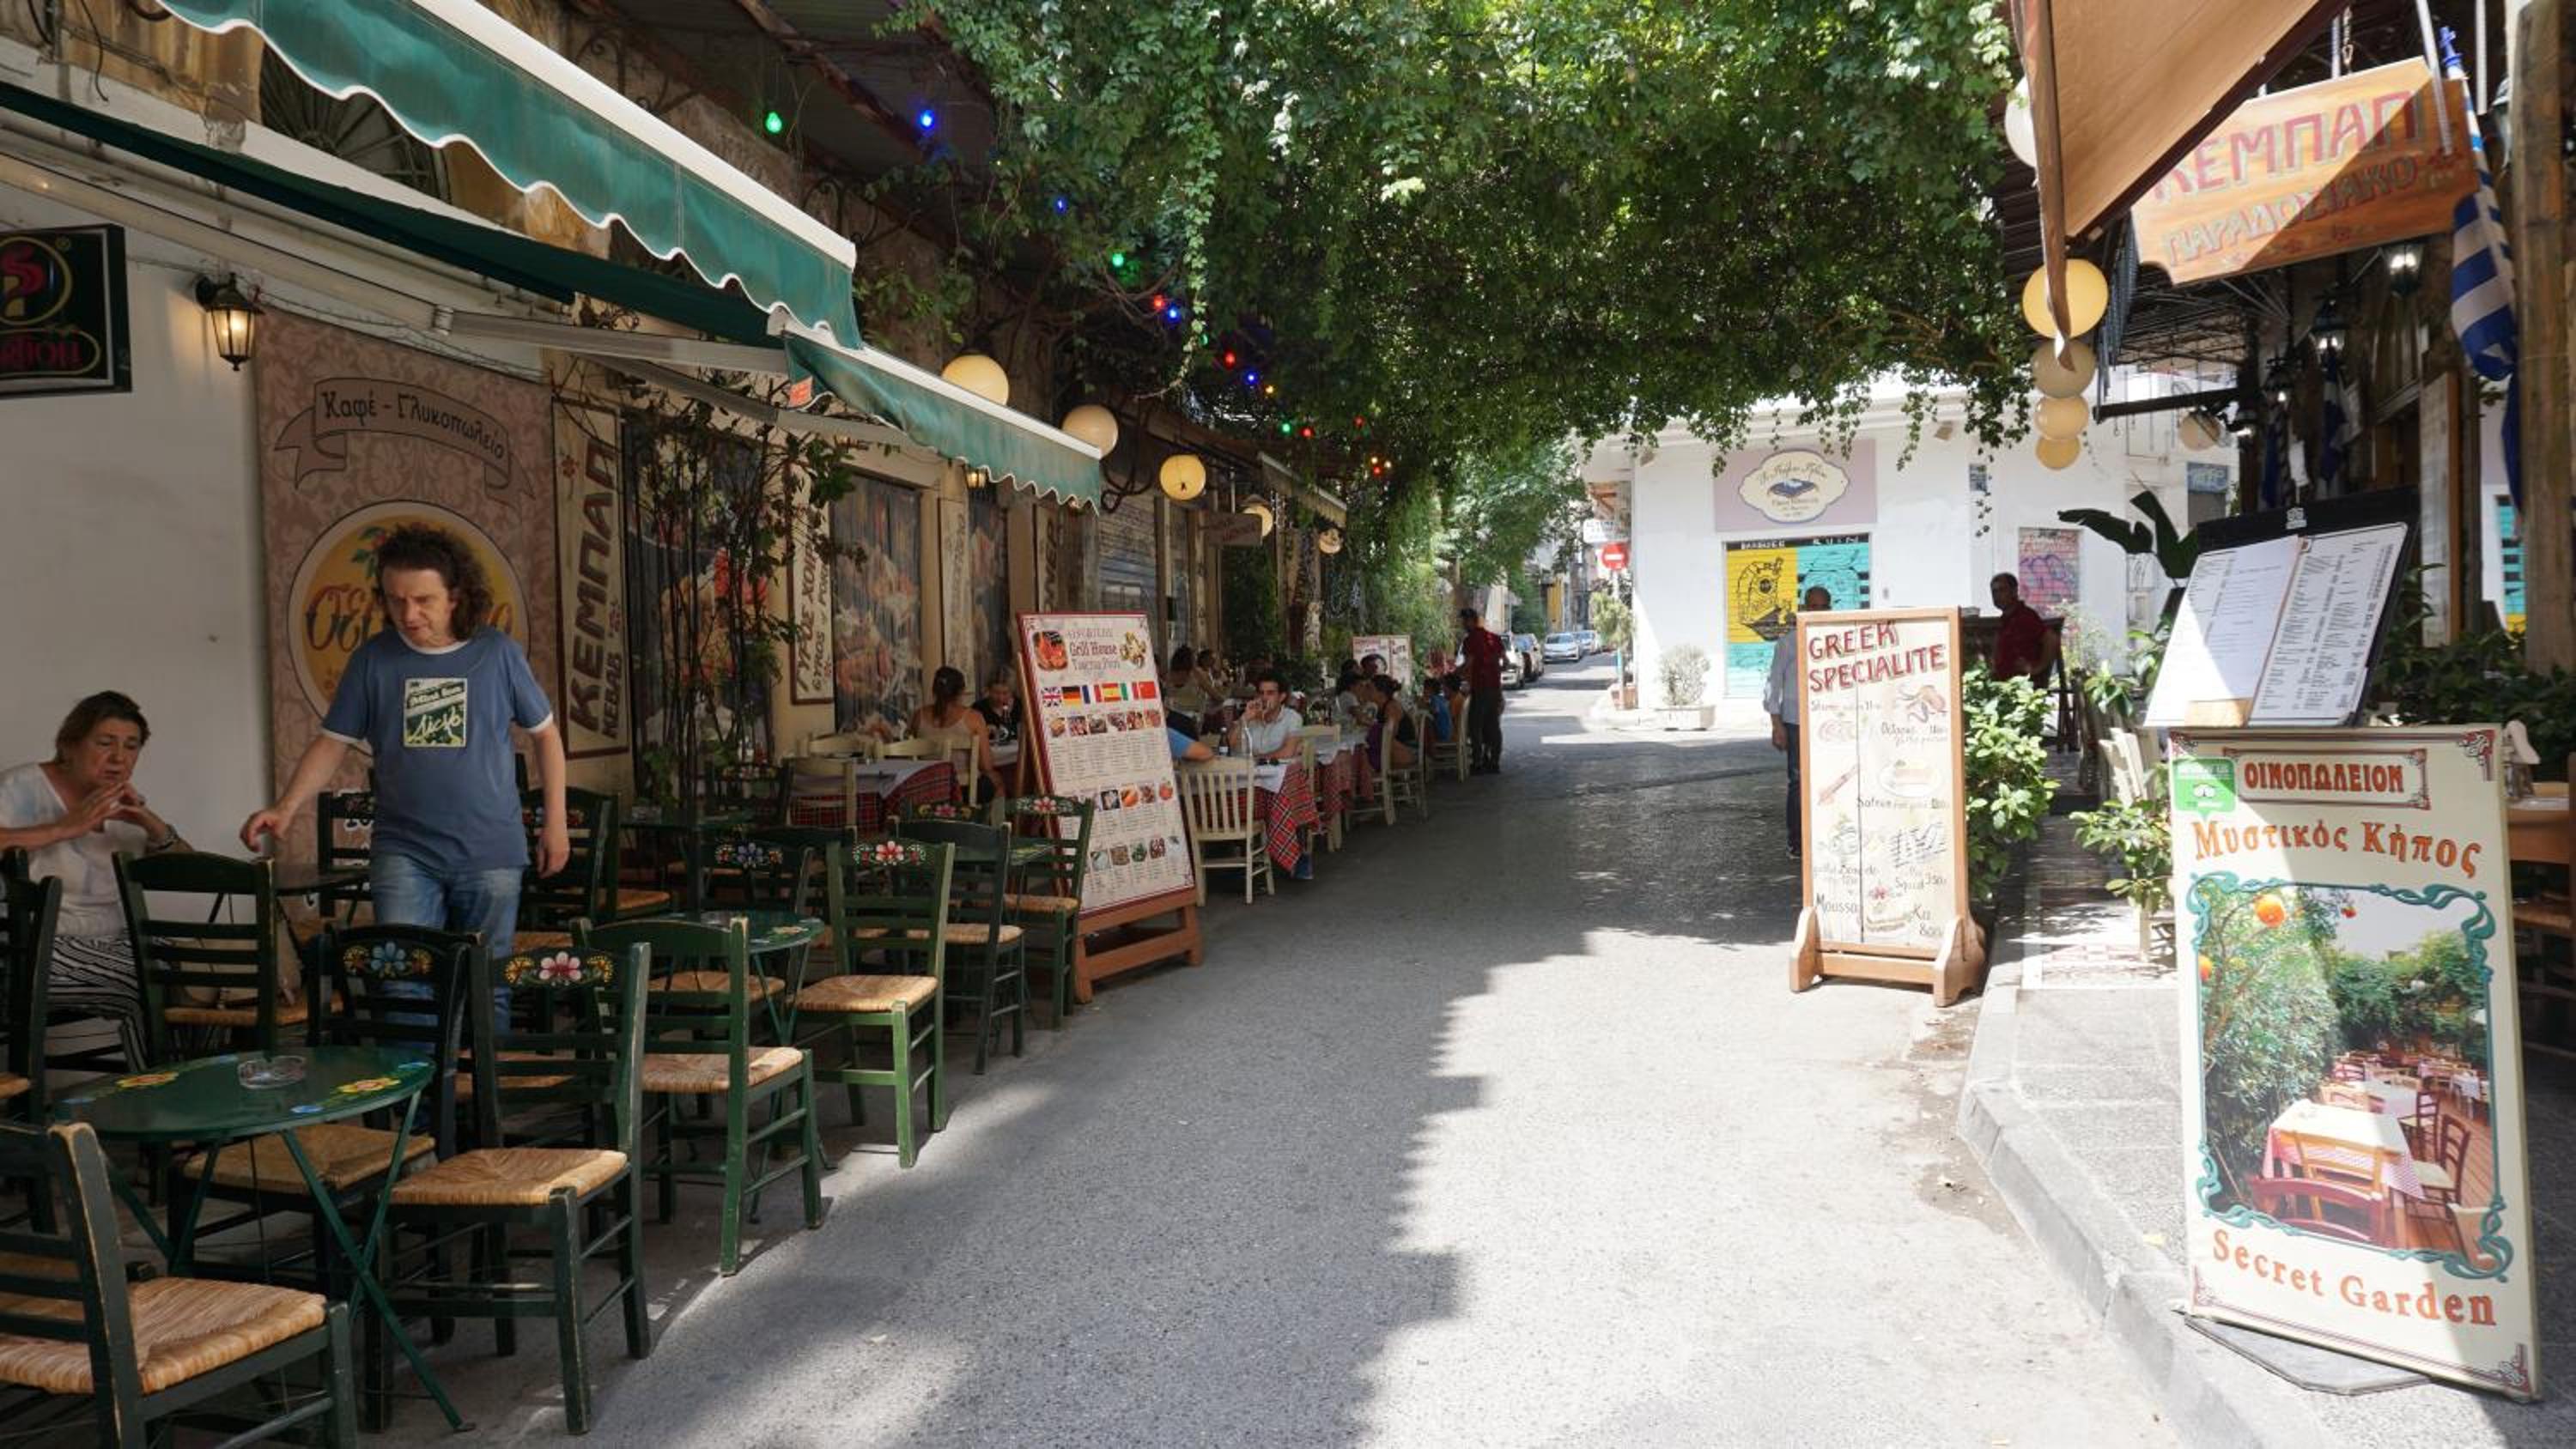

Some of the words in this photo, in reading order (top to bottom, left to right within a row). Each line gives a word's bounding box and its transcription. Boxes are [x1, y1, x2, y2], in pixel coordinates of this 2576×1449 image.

[321, 391, 377, 427] Καφέ
[397, 392, 505, 459] Γλυκοπωλείο
[1809, 620, 1899, 661] GREEK
[1809, 644, 1947, 693] SPECIALITE
[2244, 761, 2405, 793] ΟΙΝΟΠΩΛΕΙΟΝ
[2191, 819, 2349, 860] Μυστικός
[2361, 821, 2482, 879] Κήπος
[2213, 1229, 2324, 1297] Secret
[2340, 1275, 2498, 1326] Garden
